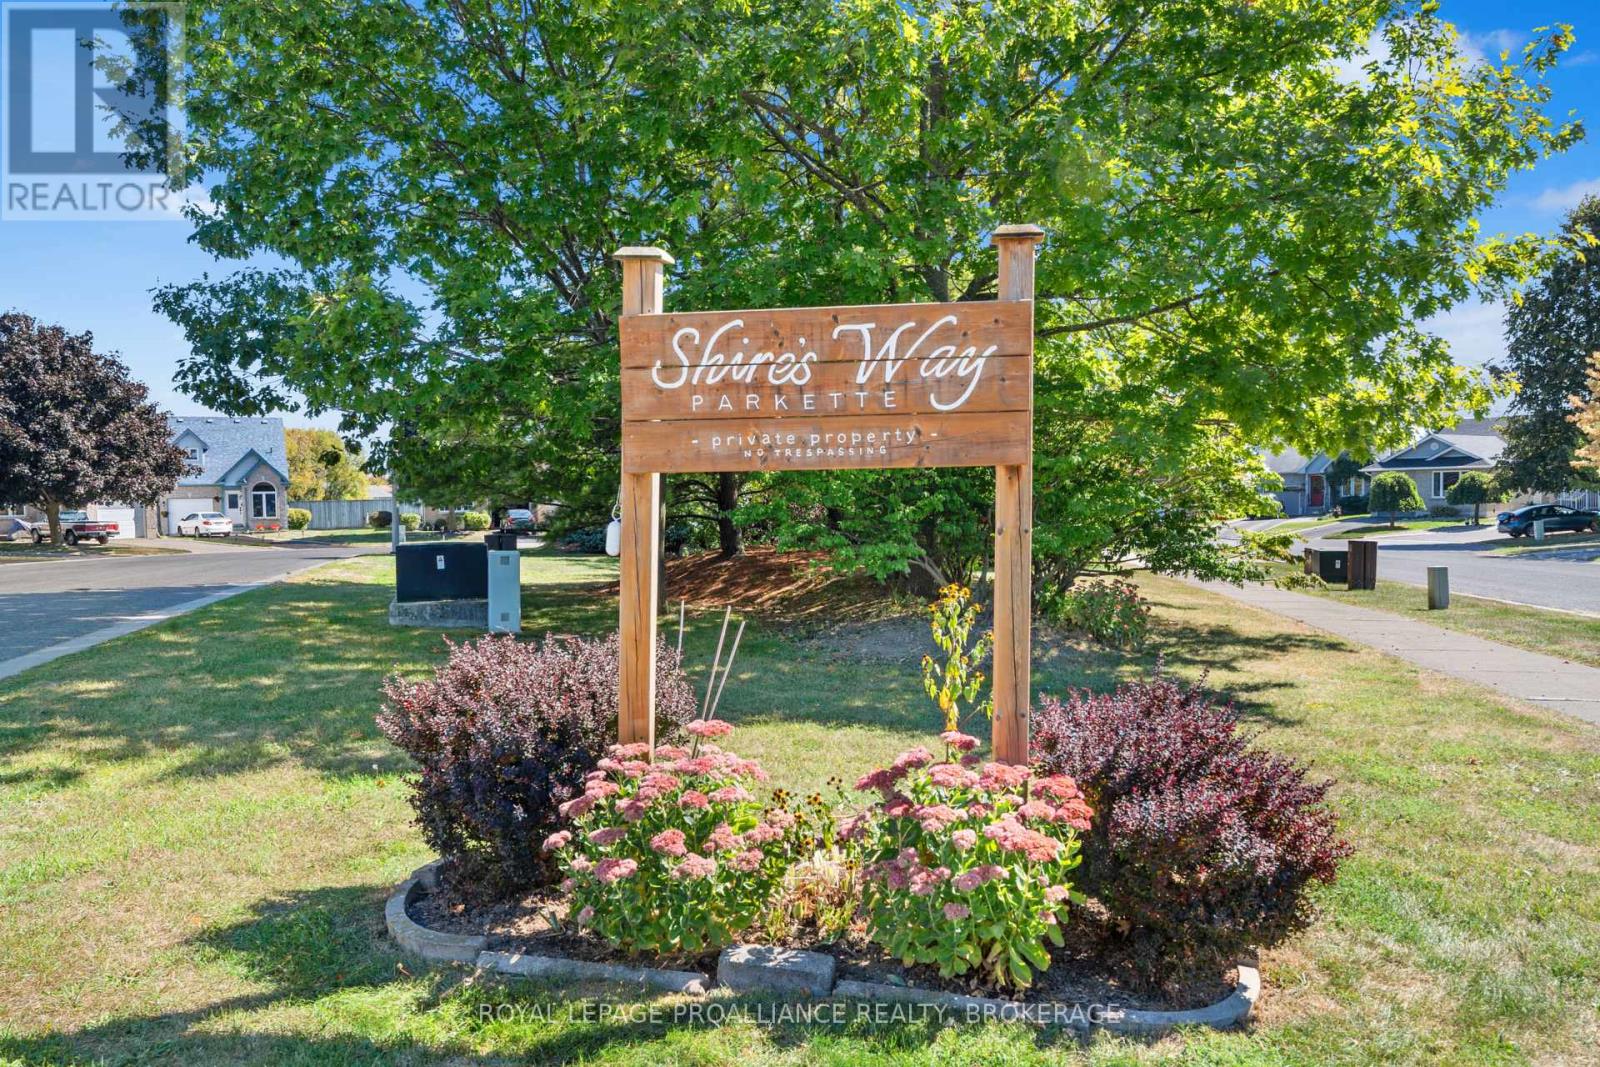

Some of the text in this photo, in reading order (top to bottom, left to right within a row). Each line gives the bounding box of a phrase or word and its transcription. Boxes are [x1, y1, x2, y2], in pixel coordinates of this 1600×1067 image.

[651, 314, 998, 412] Shire's Way
[691, 391, 897, 411] PARKETTE
[712, 432, 796, 449] private
[810, 429, 915, 447] property
[744, 446, 887, 457] NO TRESPASSING
